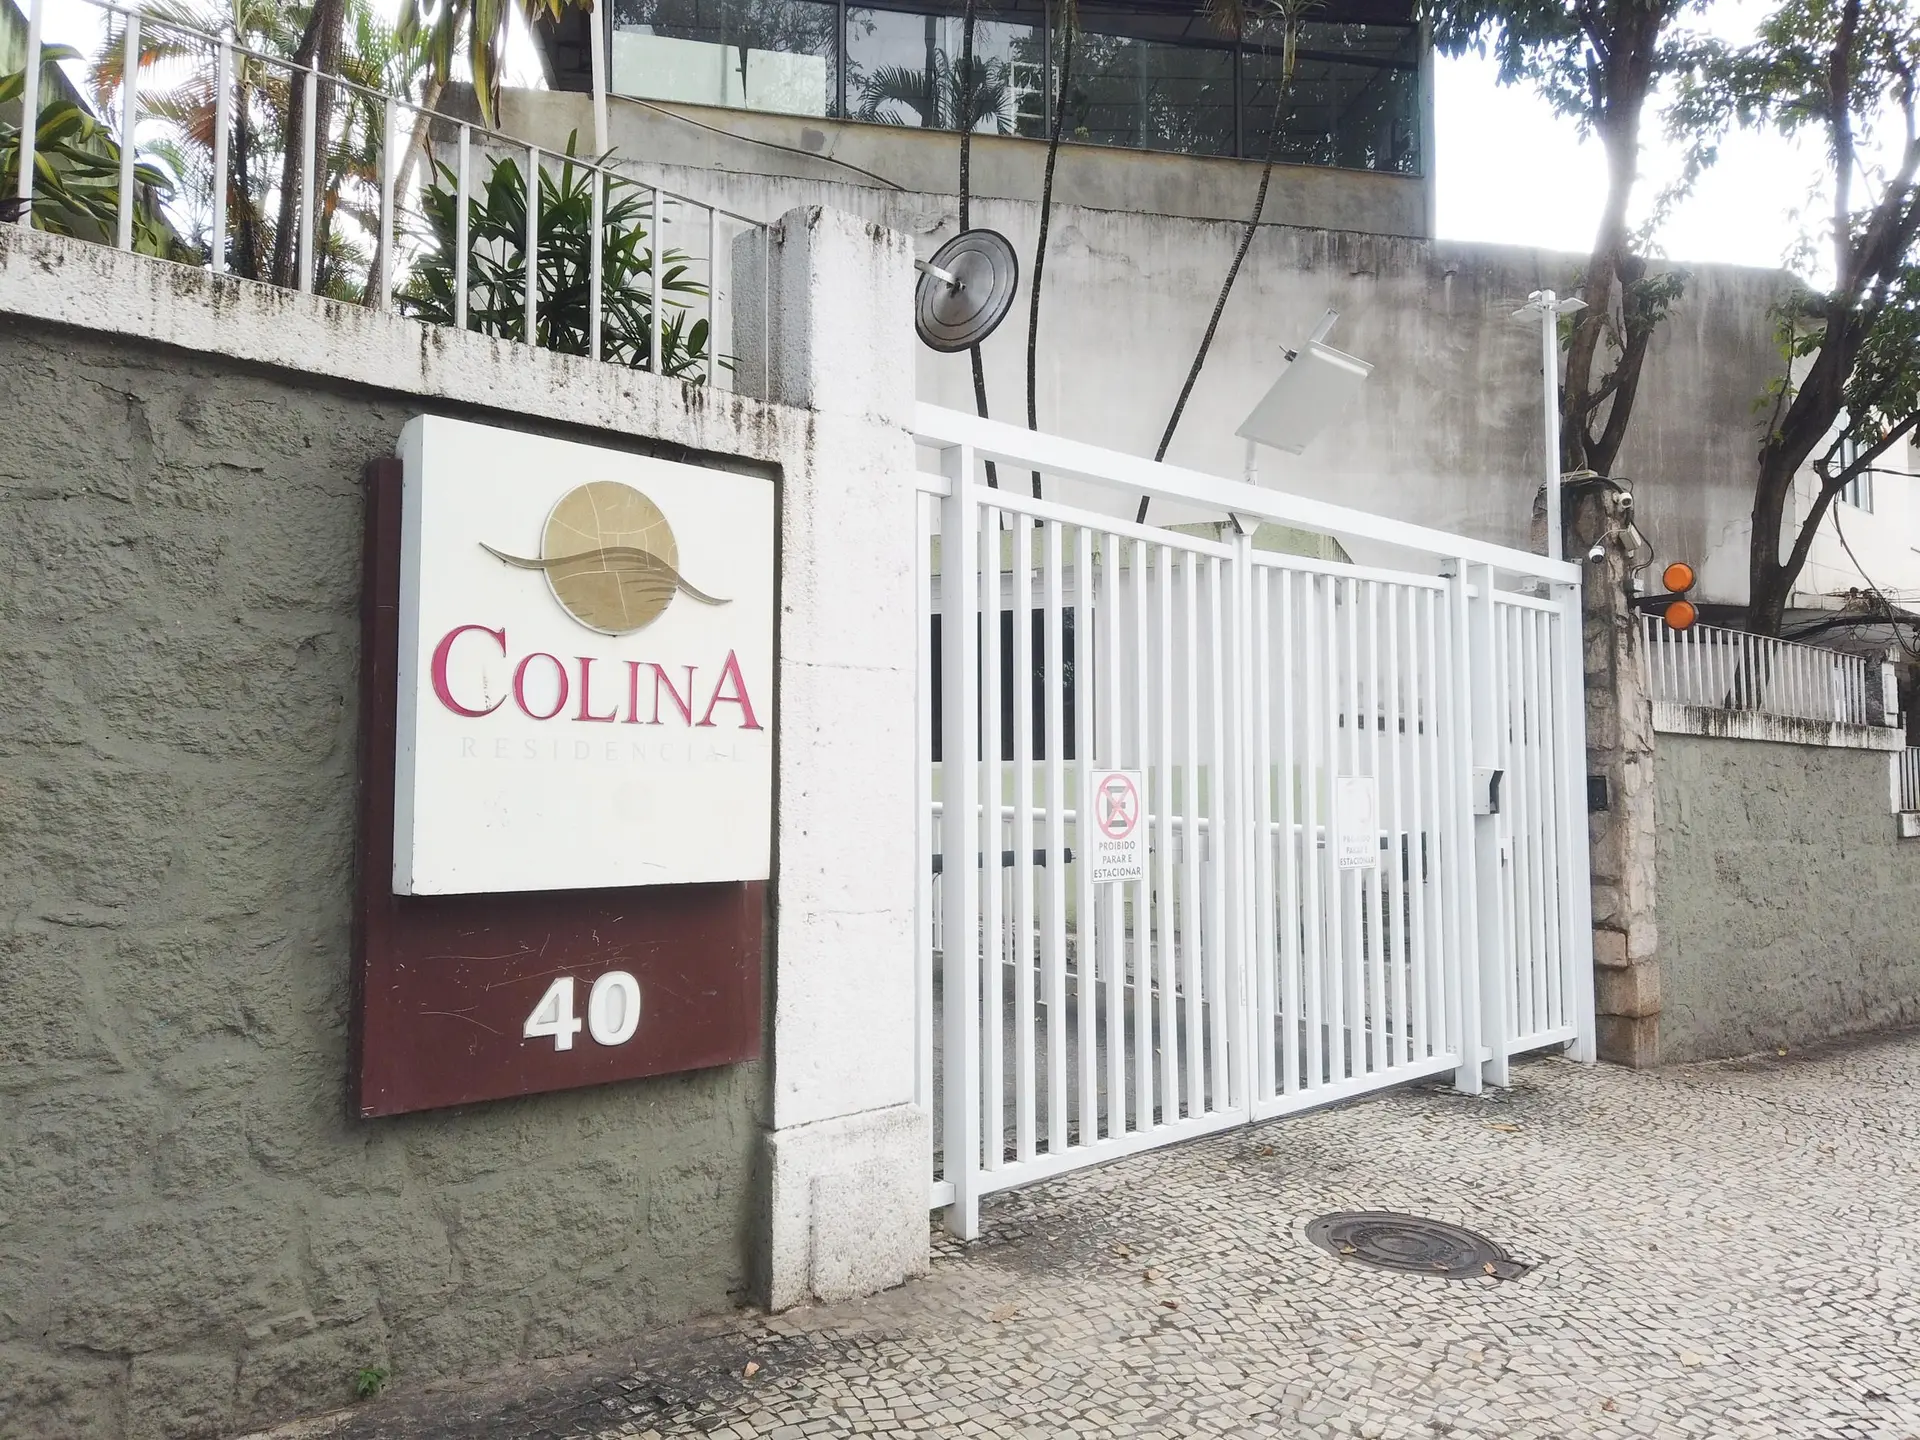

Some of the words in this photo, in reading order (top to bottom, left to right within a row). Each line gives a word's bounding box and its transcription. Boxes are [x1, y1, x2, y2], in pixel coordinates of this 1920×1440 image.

[431, 624, 764, 732] COLINA
[460, 736, 746, 763] RESIDENCIAL
[1099, 841, 1136, 852] PROIBIDO
[1102, 854, 1126, 864] PARAR
[1128, 853, 1132, 863] E
[1094, 866, 1141, 878] ESTACIONAR
[523, 971, 641, 1051] 40
